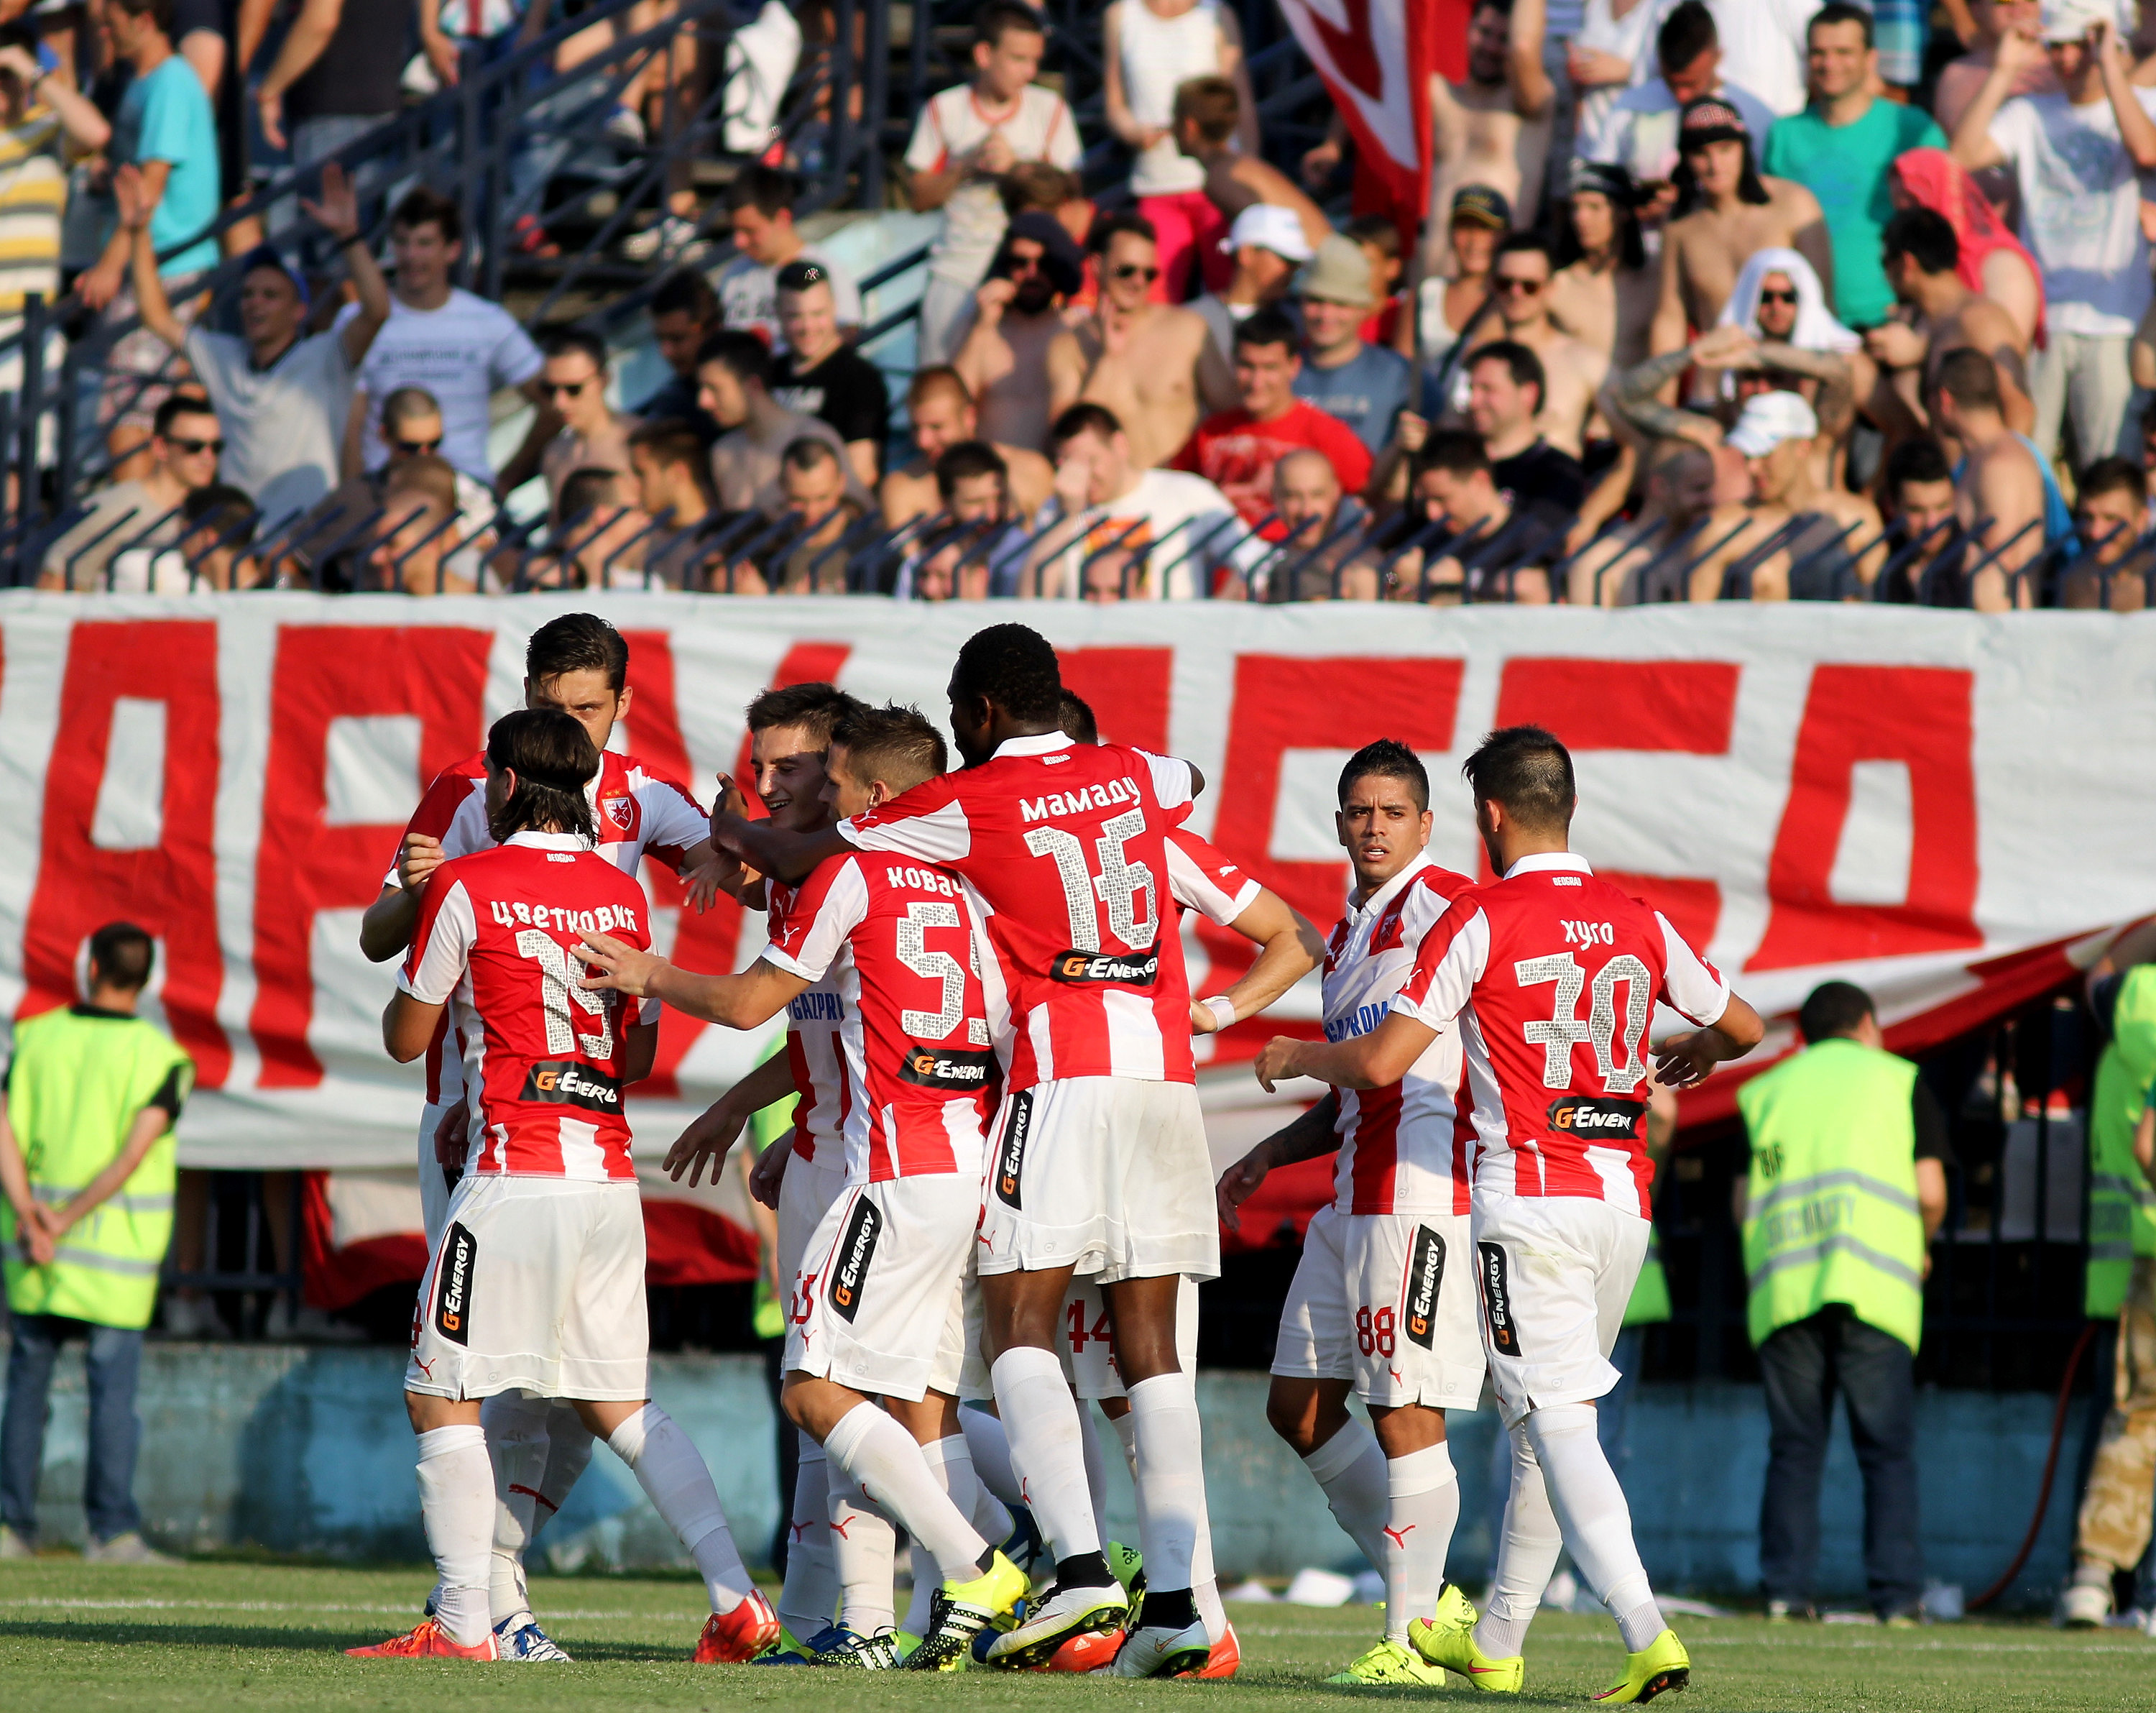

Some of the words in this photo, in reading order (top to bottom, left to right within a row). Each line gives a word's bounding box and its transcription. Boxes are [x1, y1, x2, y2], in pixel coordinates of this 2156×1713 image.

[1042, 754, 1071, 766] BEOGRAD
[1022, 806, 1160, 954] 16
[1552, 876, 1582, 887] BEOGRAD
[515, 928, 617, 1060] 19
[895, 901, 993, 1047] 5
[1062, 957, 1158, 979] G-ENERG
[1513, 951, 1651, 1094] 70
[536, 1070, 617, 1104] G-ENERG
[443, 1235, 469, 1331] G-ENERGY
[835, 1211, 875, 1307] G-ENERGY
[1411, 1238, 1440, 1336] G-ENERGY
[1490, 1252, 1510, 1346] G-ENERGY
[1355, 1305, 1396, 1359] 88
